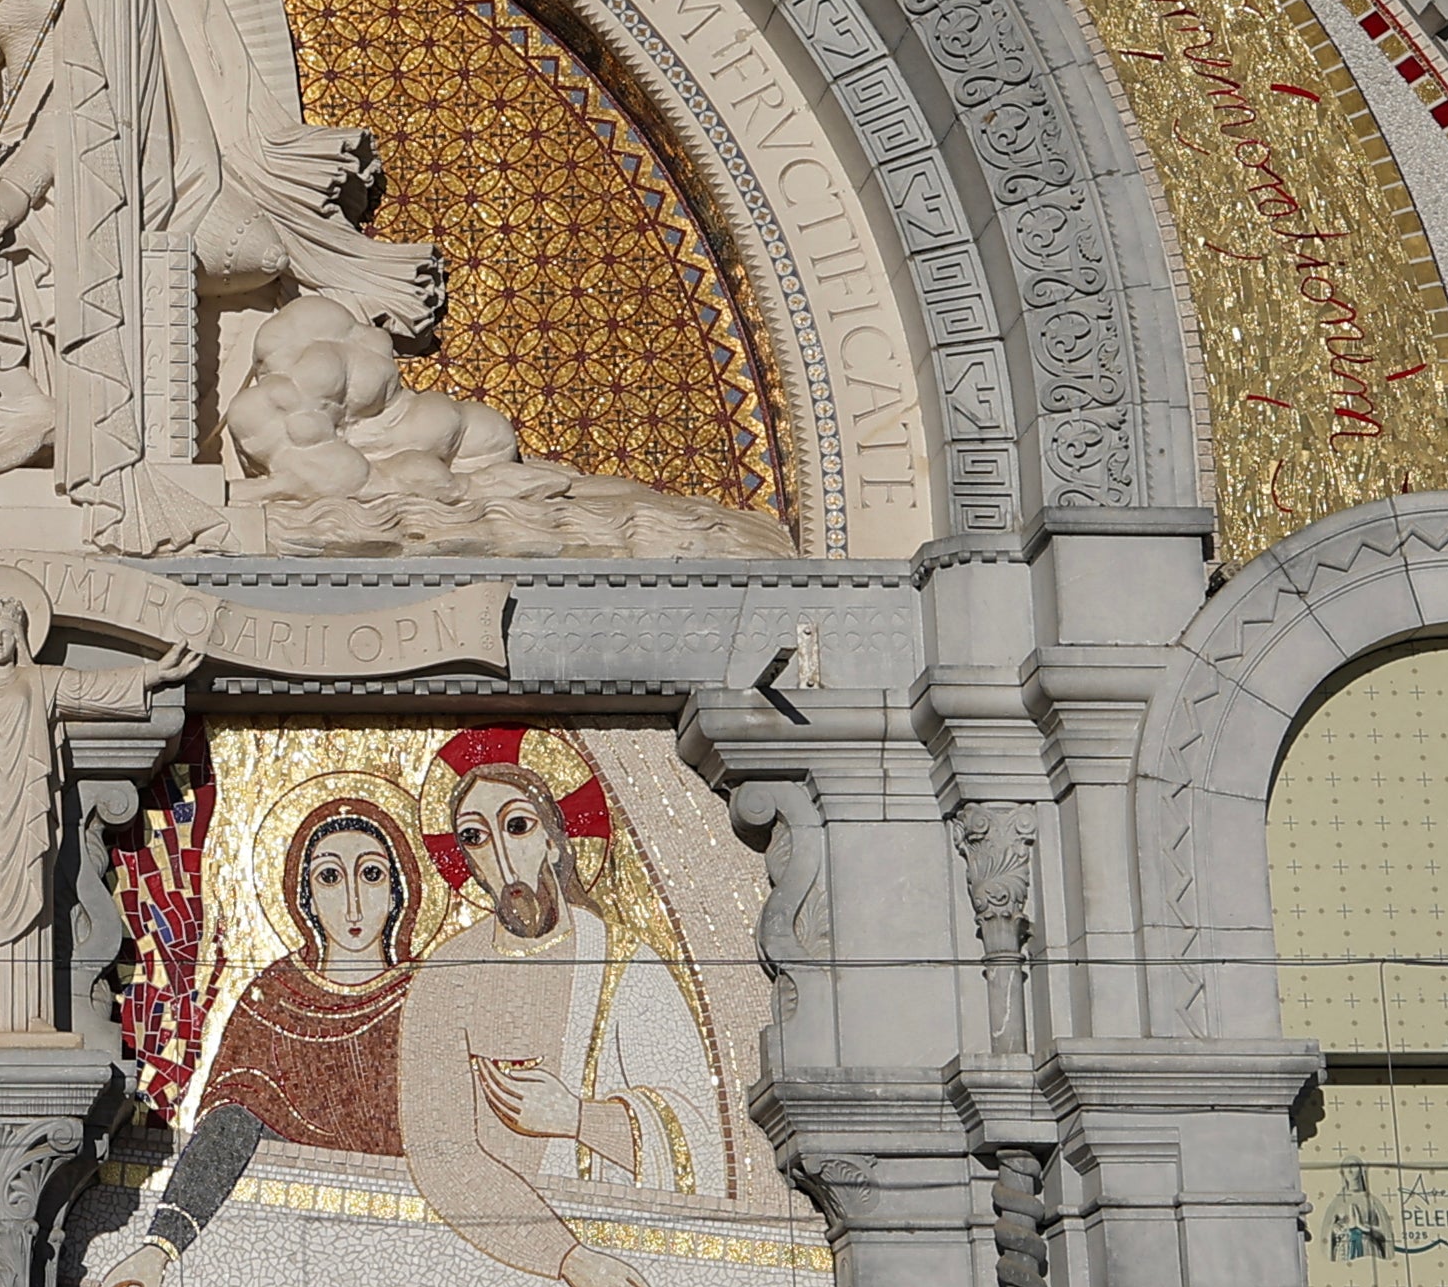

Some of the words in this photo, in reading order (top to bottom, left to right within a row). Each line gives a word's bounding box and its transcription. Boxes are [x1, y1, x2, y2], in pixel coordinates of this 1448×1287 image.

[709, 48, 918, 510] FRVCTIFICATE
[136, 581, 331, 667] ROSARII
[347, 607, 465, 663] O.P.N.
